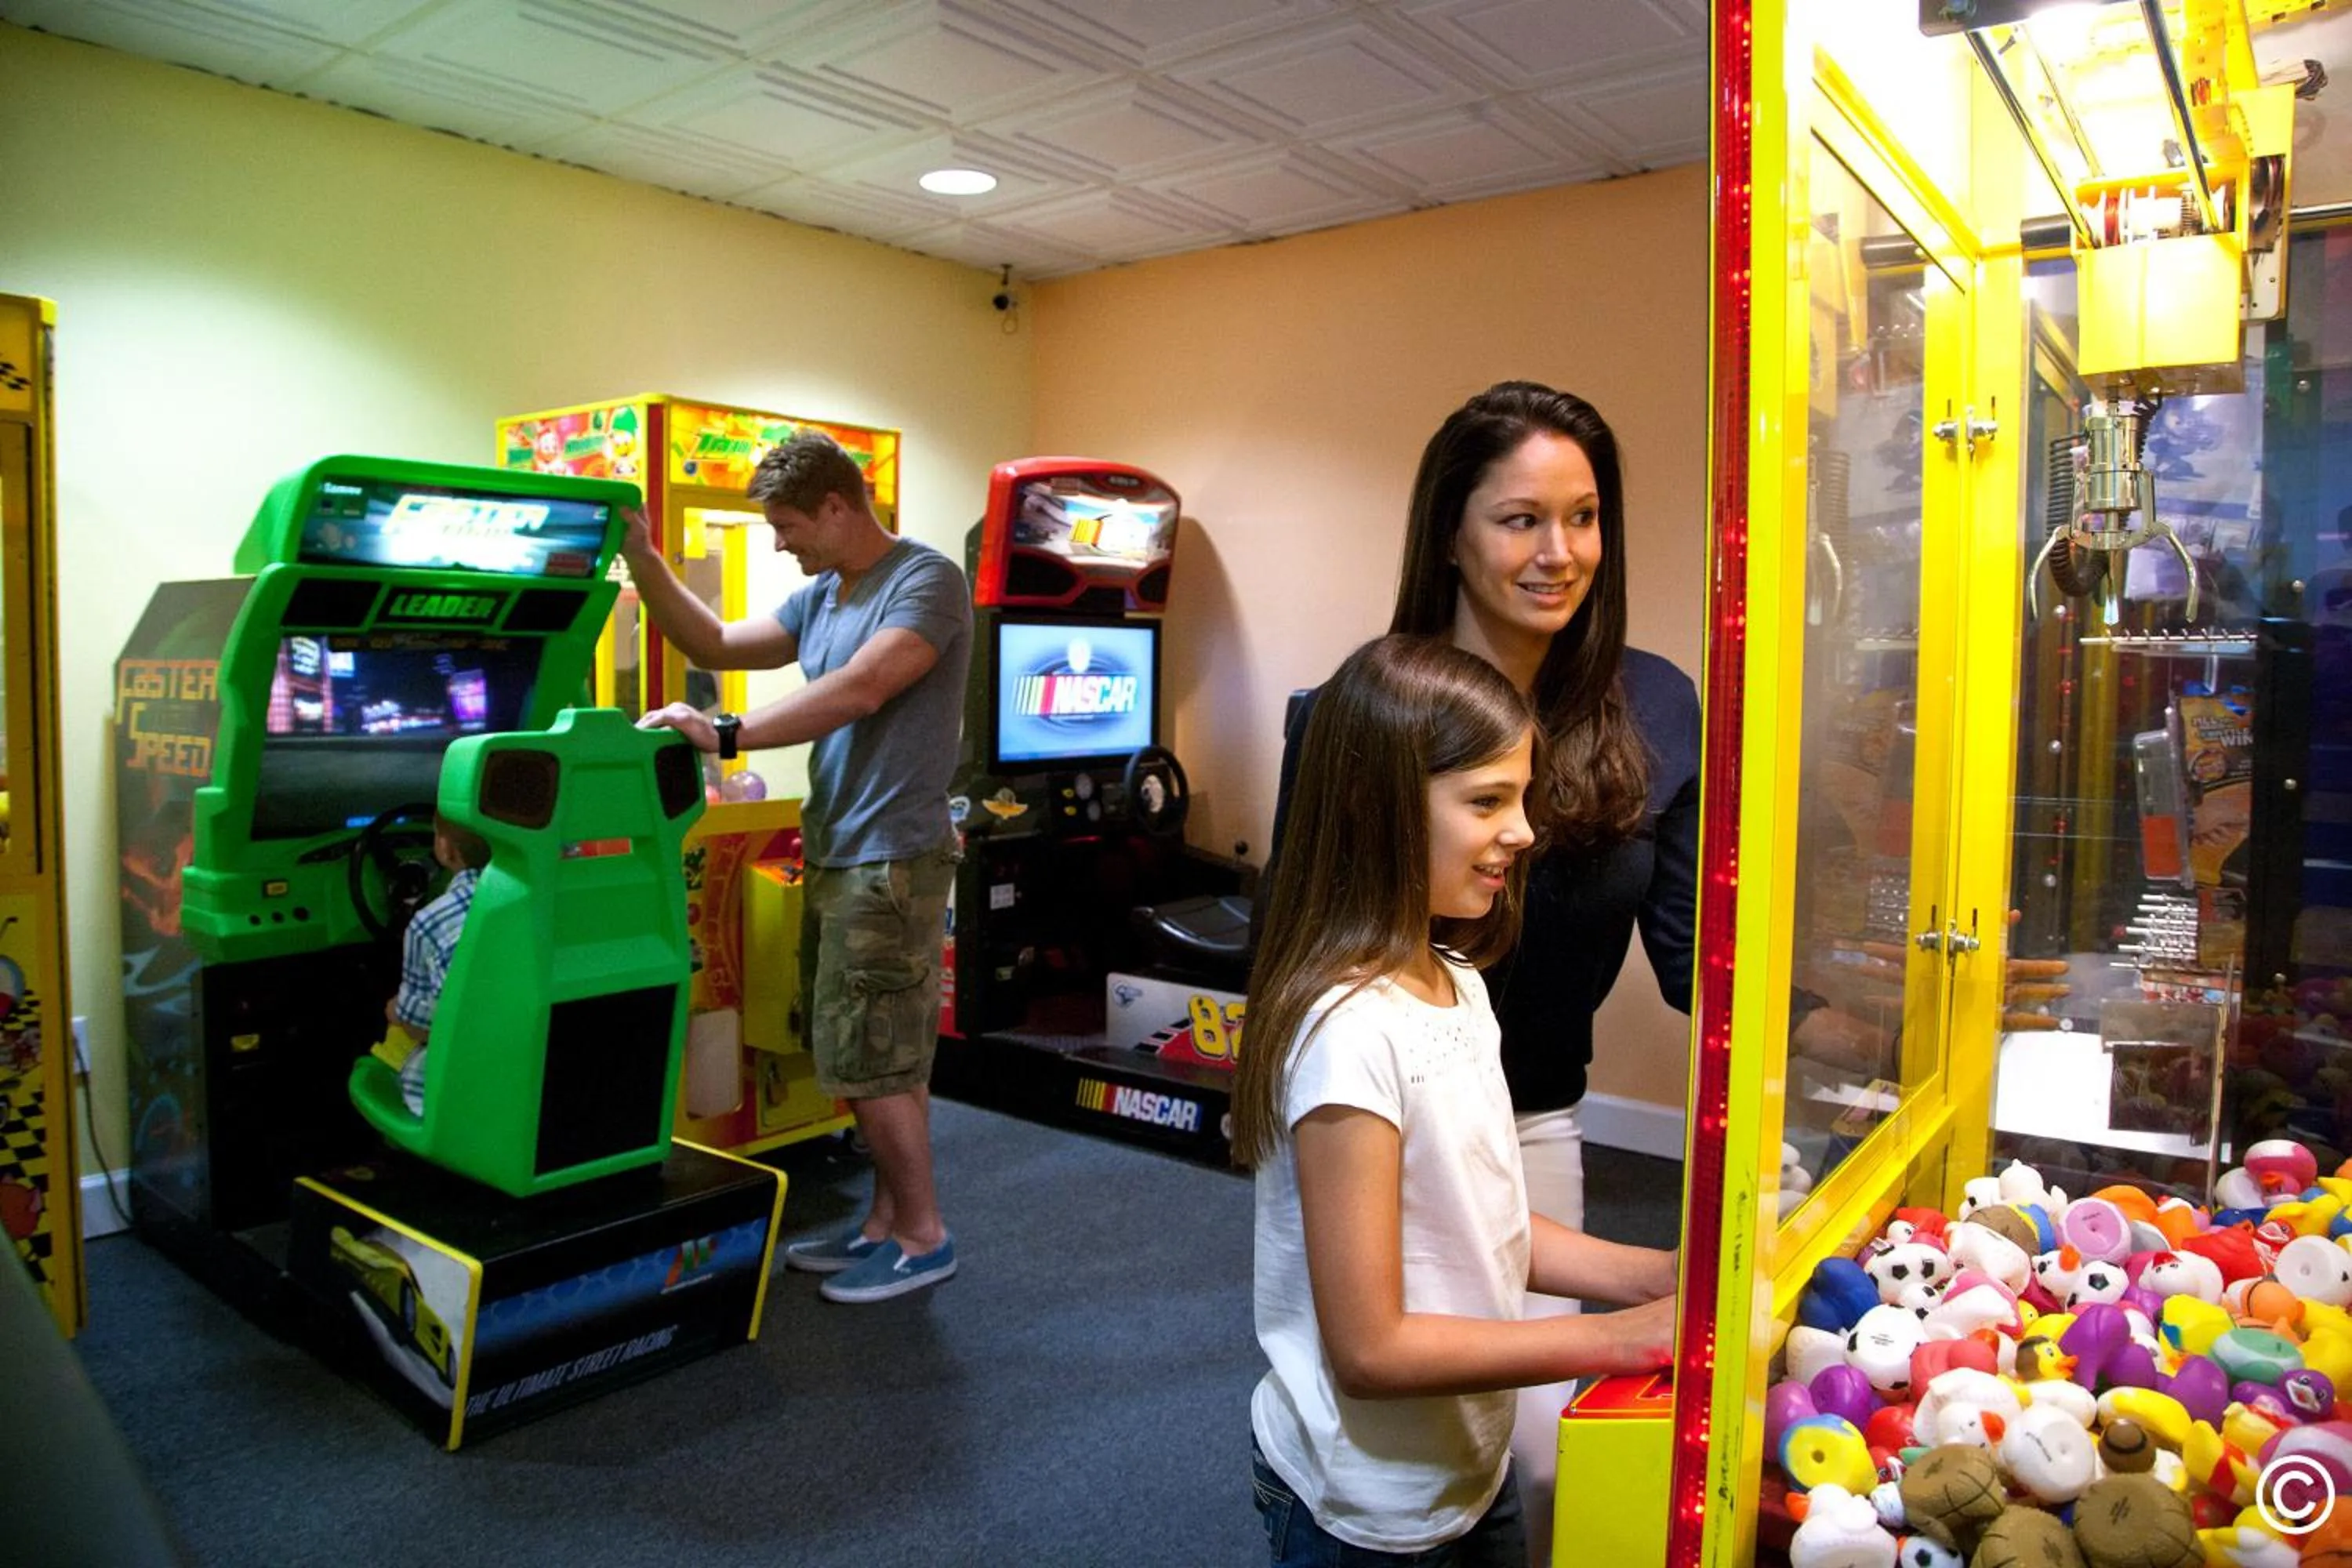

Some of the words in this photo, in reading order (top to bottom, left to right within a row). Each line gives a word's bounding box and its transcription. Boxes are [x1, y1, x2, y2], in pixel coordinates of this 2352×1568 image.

[389, 593, 497, 618] LEADER
[1054, 675, 1137, 714] NASCAR
[1112, 1086, 1199, 1133] NASCAR
